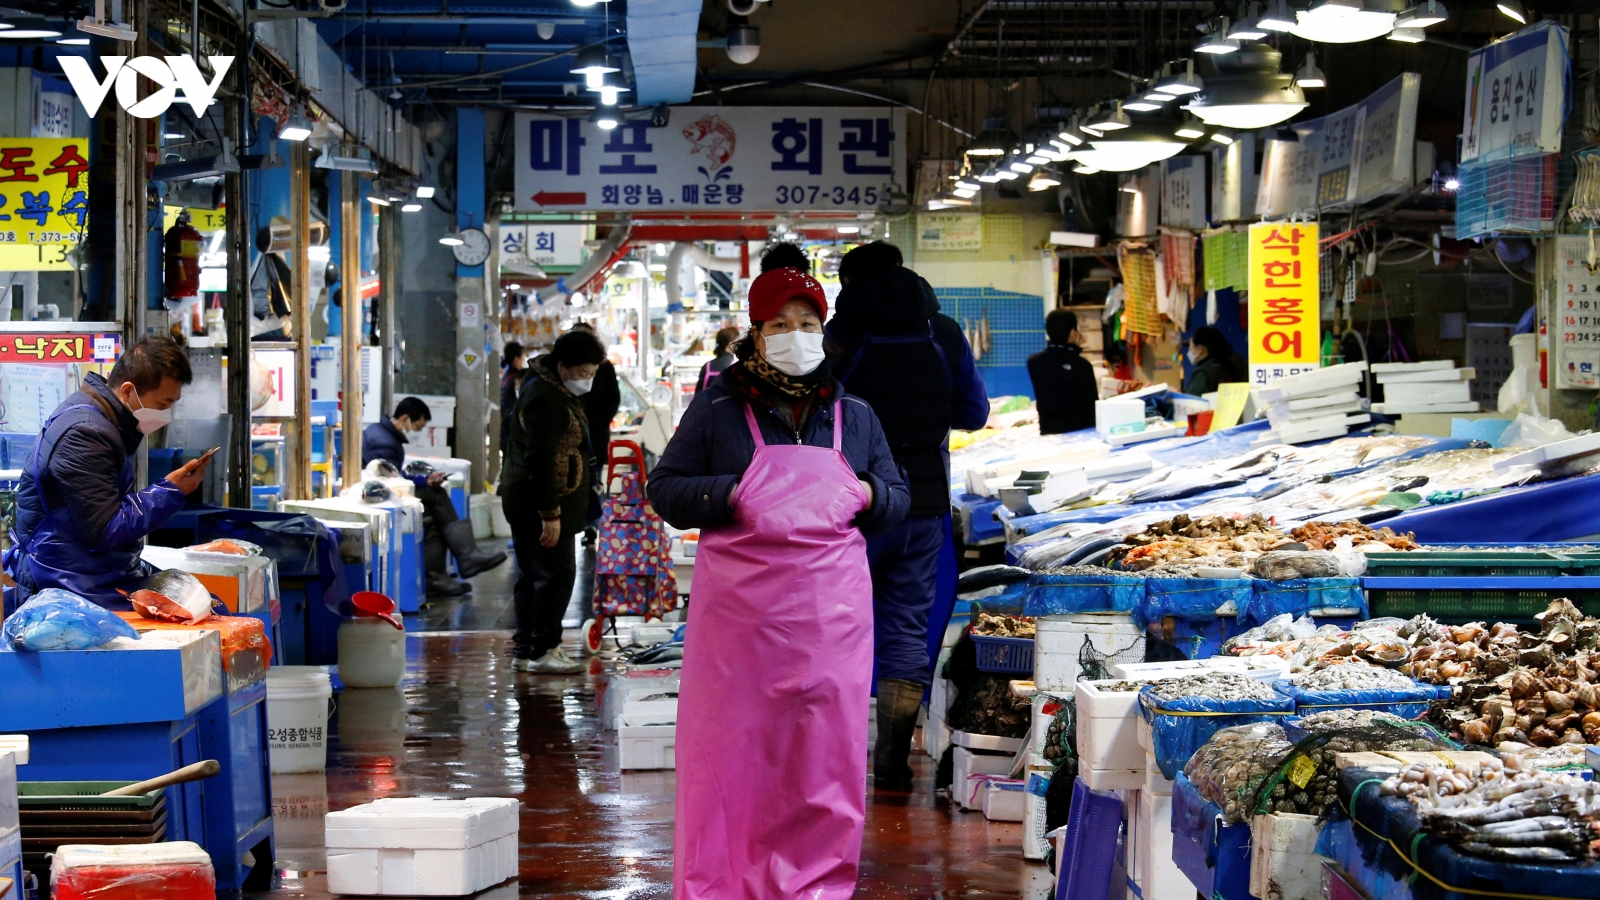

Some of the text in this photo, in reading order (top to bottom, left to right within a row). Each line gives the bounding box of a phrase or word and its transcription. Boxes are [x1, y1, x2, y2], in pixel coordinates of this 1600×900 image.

[530, 118, 895, 176] 마포 회관
[1567, 284, 1574, 293] 2
[1581, 285, 1587, 293] 3
[1567, 300, 1574, 309] 9
[1580, 301, 1589, 309] 10
[1565, 316, 1575, 326] 16
[1579, 316, 1588, 325] 17
[1262, 297, 1303, 359] 홍어
[1564, 333, 1576, 343] 23
[1578, 333, 1589, 341] 24
[268, 727, 323, 742] 오성종합식품
